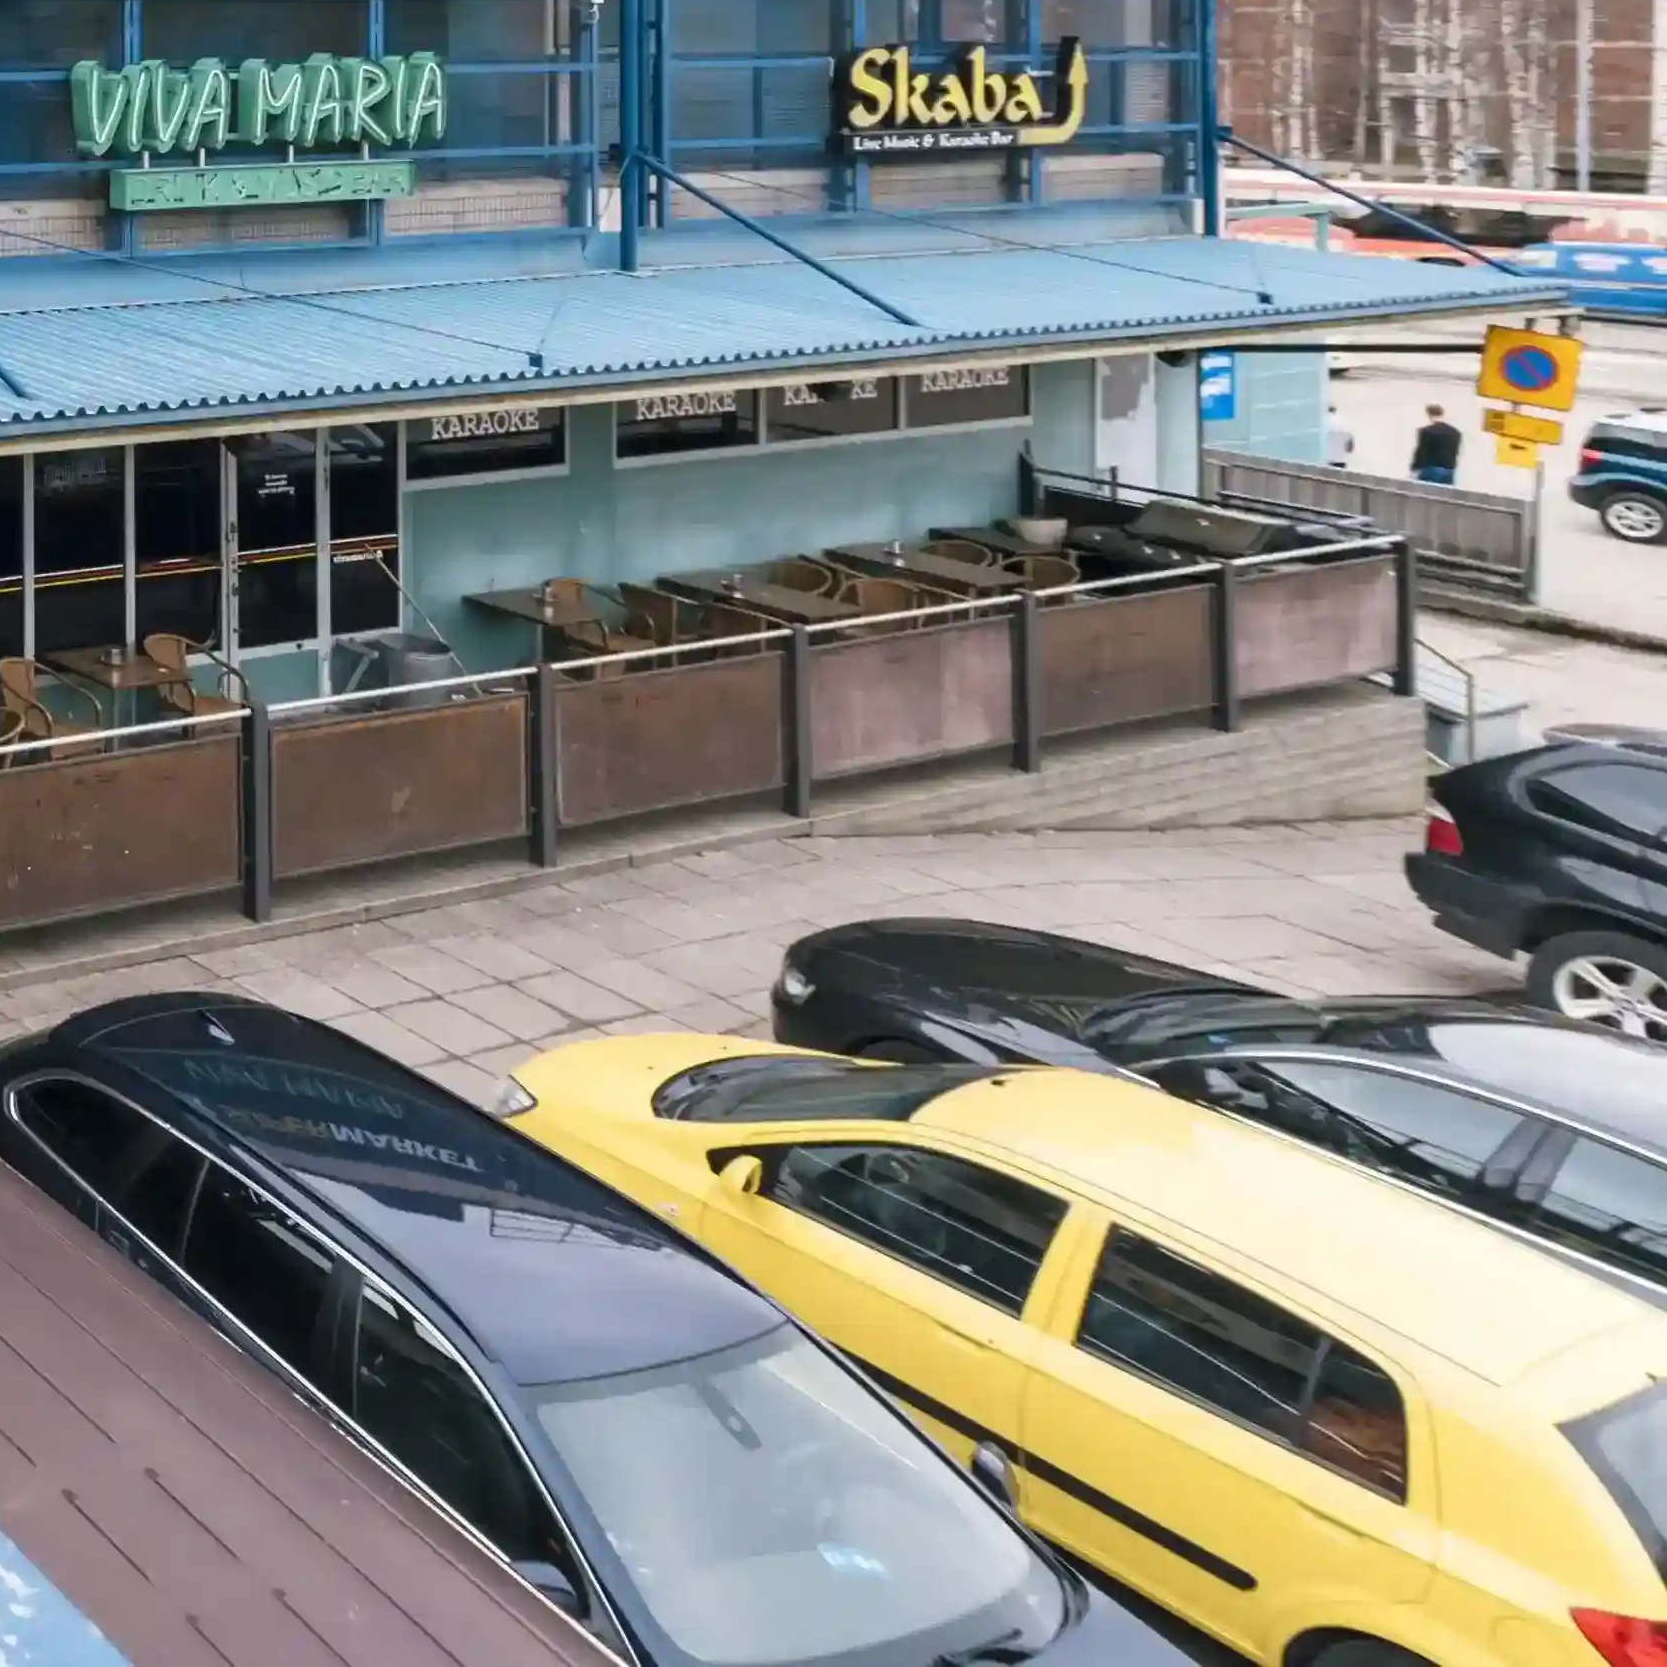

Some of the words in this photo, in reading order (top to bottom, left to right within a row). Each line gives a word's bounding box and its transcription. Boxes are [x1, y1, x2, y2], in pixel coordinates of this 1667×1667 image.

[848, 44, 1043, 128] Skaba
[71, 57, 231, 156] VIVA
[239, 51, 448, 149] MARIA
[783, 377, 879, 406] KAKE
[920, 366, 1011, 394] KARAOKE
[635, 390, 737, 421] KARAOKE
[430, 408, 540, 441] KARAOKE
